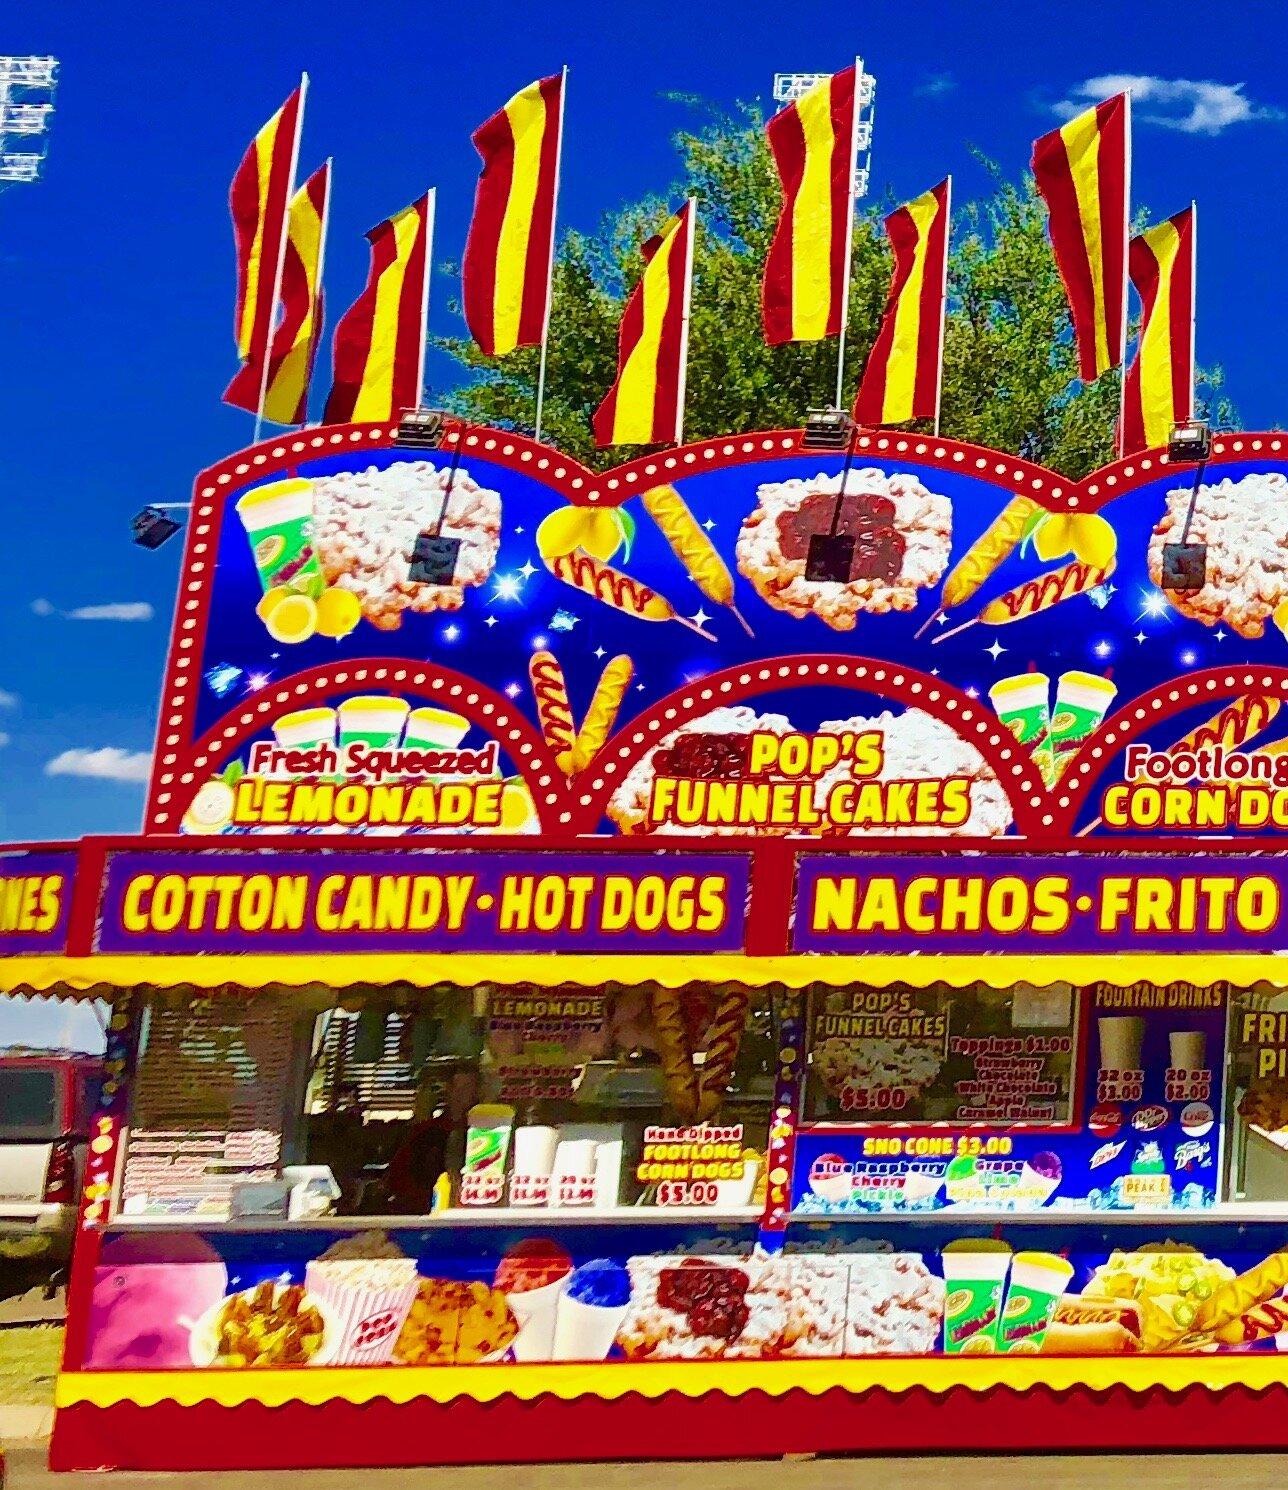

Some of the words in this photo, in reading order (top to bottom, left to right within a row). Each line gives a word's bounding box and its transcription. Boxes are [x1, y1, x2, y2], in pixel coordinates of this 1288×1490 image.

[252, 743, 337, 773] Fresh
[346, 743, 496, 781] Squeezed
[750, 733, 881, 776] POP'S
[234, 783, 501, 823] LEMONADE
[652, 777, 818, 824] FUNNEL
[829, 778, 971, 825] CAKES
[1104, 786, 1226, 826] CORN
[123, 874, 309, 931] COTTON
[316, 874, 475, 931] CANDY
[500, 875, 594, 931] HOT
[601, 875, 725, 931] DOGS
[812, 876, 1070, 932] NACHOS
[1100, 876, 1279, 932] FRITO
[853, 993, 911, 1011] POP'S
[1096, 983, 1166, 1009] FOUNTAIN
[1168, 984, 1222, 1009] DRINKS
[493, 1001, 604, 1016] LEMONADE
[816, 1015, 883, 1036] FUNNEL
[888, 1016, 945, 1037] CAKES
[1166, 1069, 1187, 1081] 20
[842, 1087, 906, 1111] $5.00
[643, 1143, 742, 1161] FOOTLONG
[863, 1137, 902, 1155] SNO
[905, 1137, 954, 1155] CONE
[637, 1162, 689, 1180] CORN
[691, 1161, 744, 1179] DOGS
[815, 1162, 853, 1173] Blue
[856, 1162, 945, 1176] Raspberry
[658, 1182, 720, 1204] $5.00
[851, 1176, 907, 1188] Cherry
